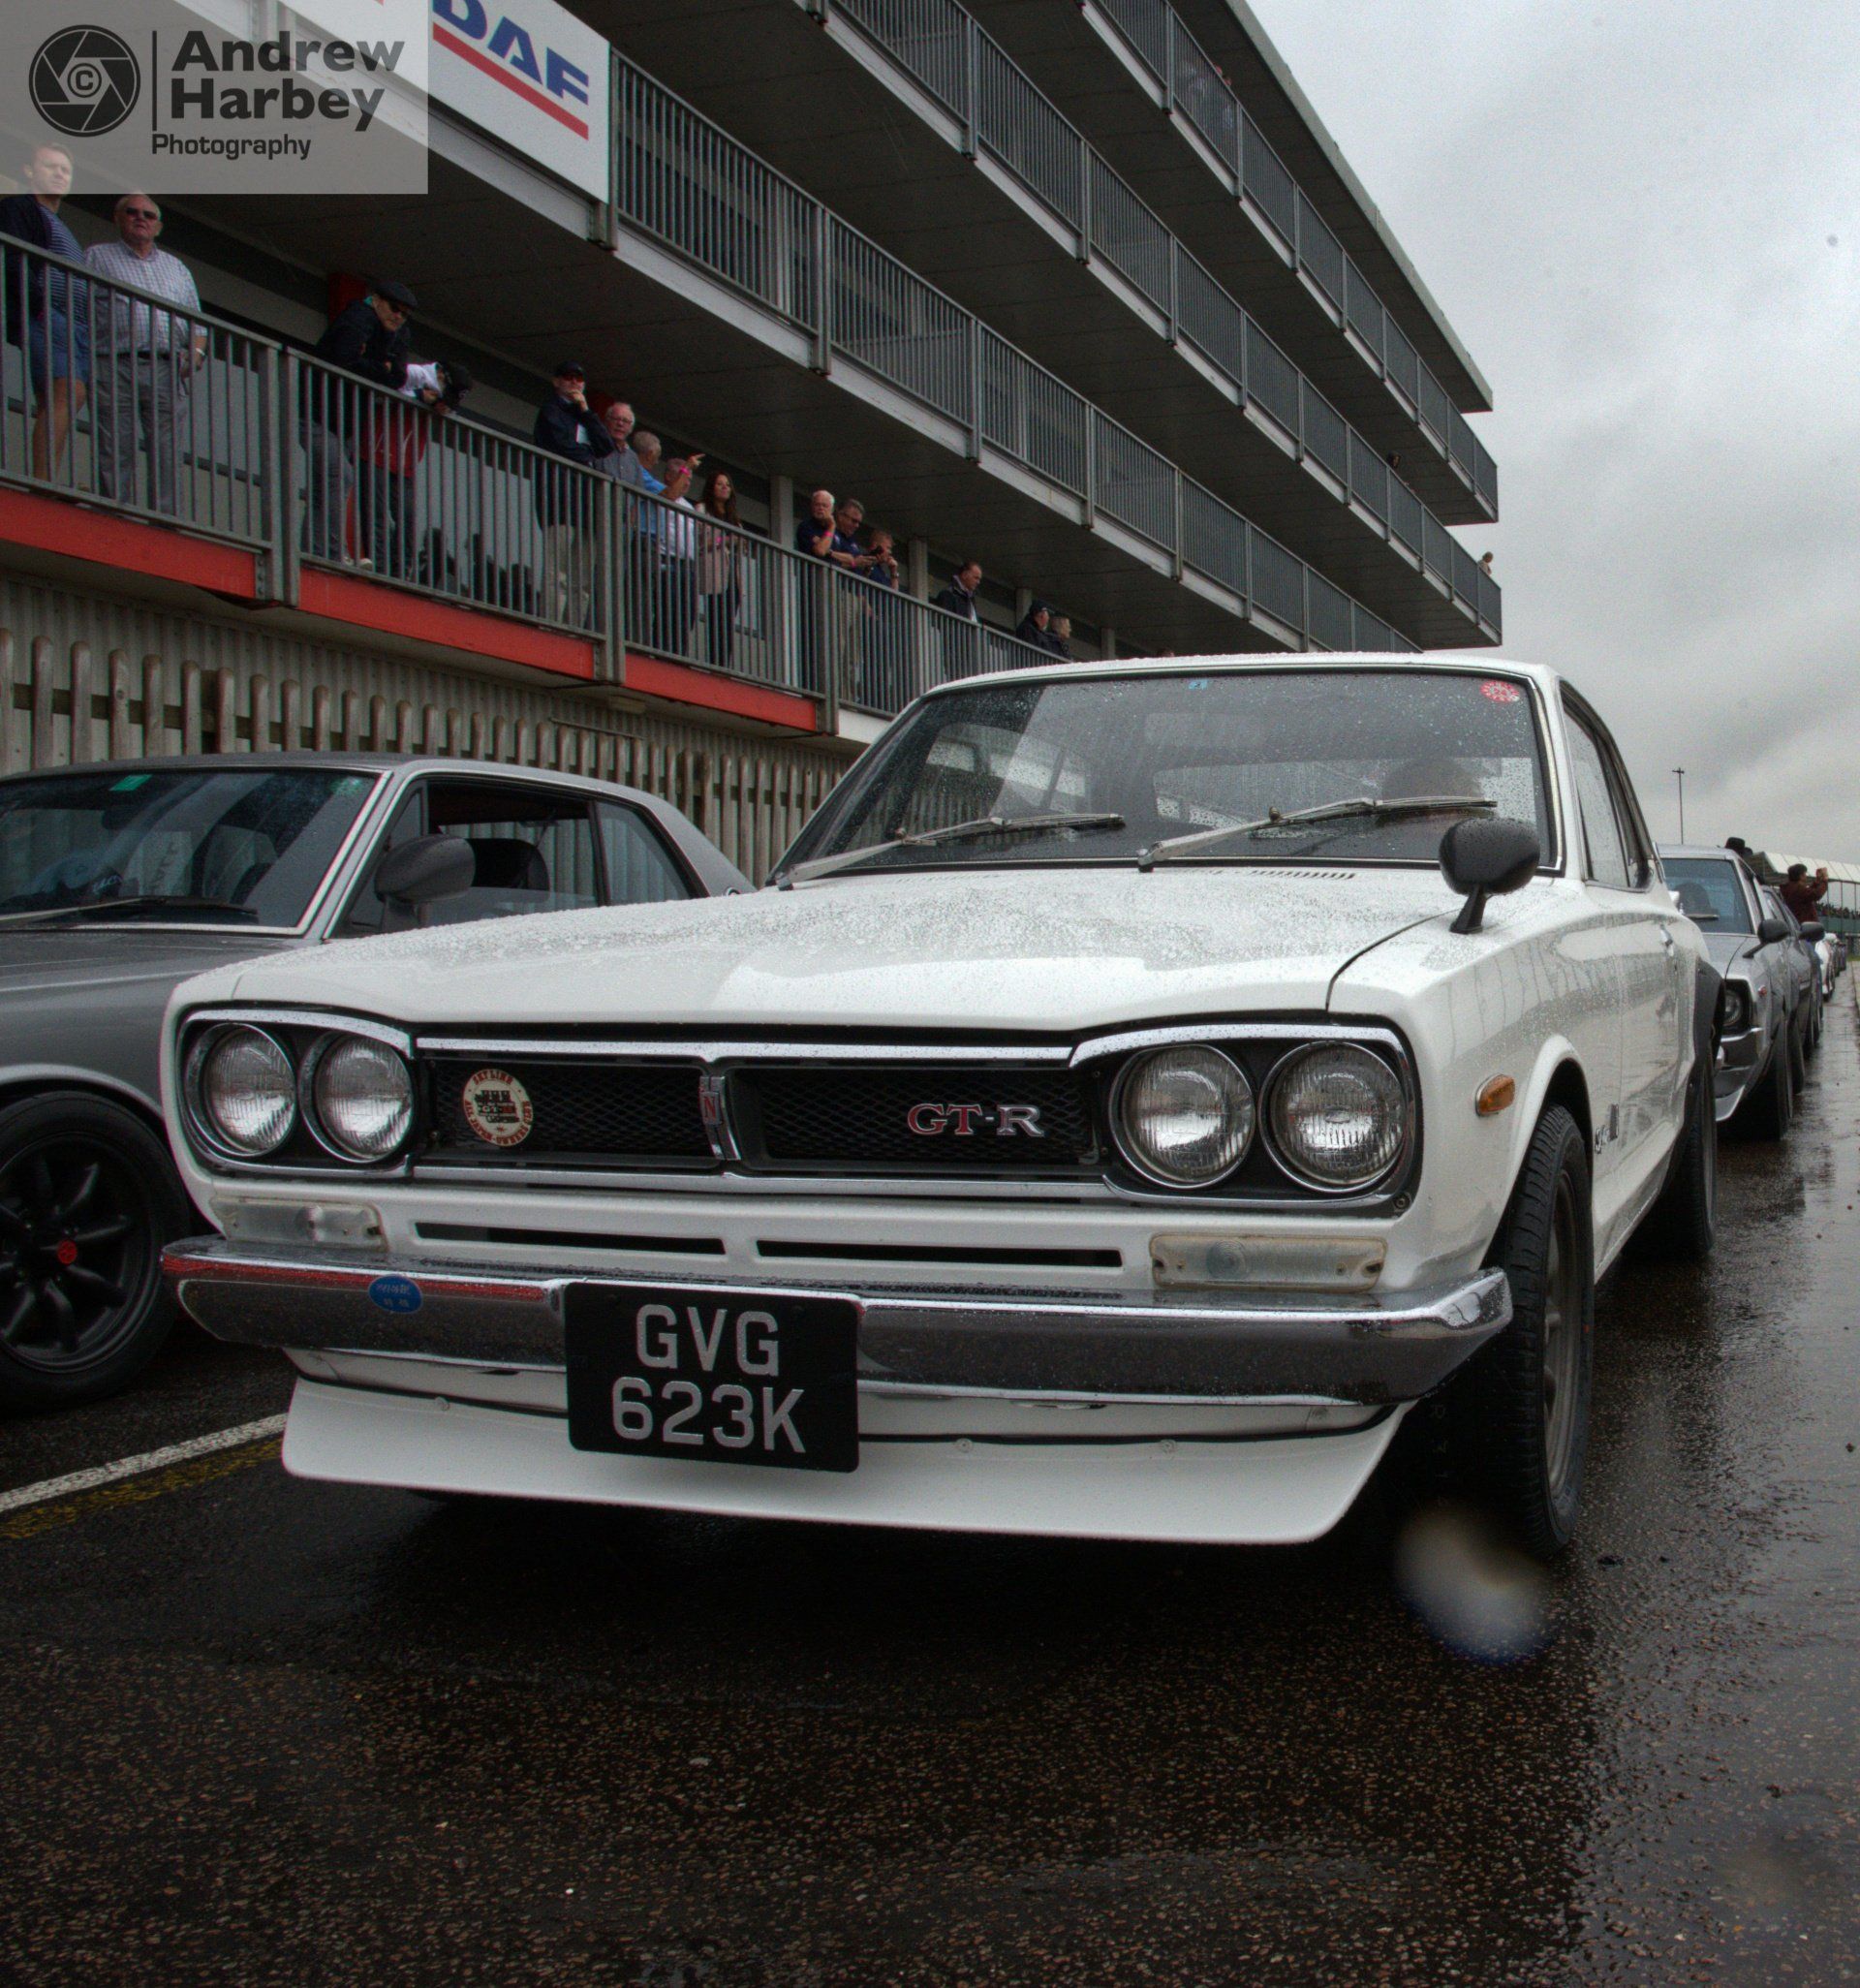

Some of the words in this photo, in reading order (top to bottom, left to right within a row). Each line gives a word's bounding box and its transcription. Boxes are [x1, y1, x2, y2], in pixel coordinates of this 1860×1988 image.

[907, 1103, 1045, 1137] GT-R
[636, 1303, 780, 1377] GVG
[611, 1376, 807, 1453] 623K
